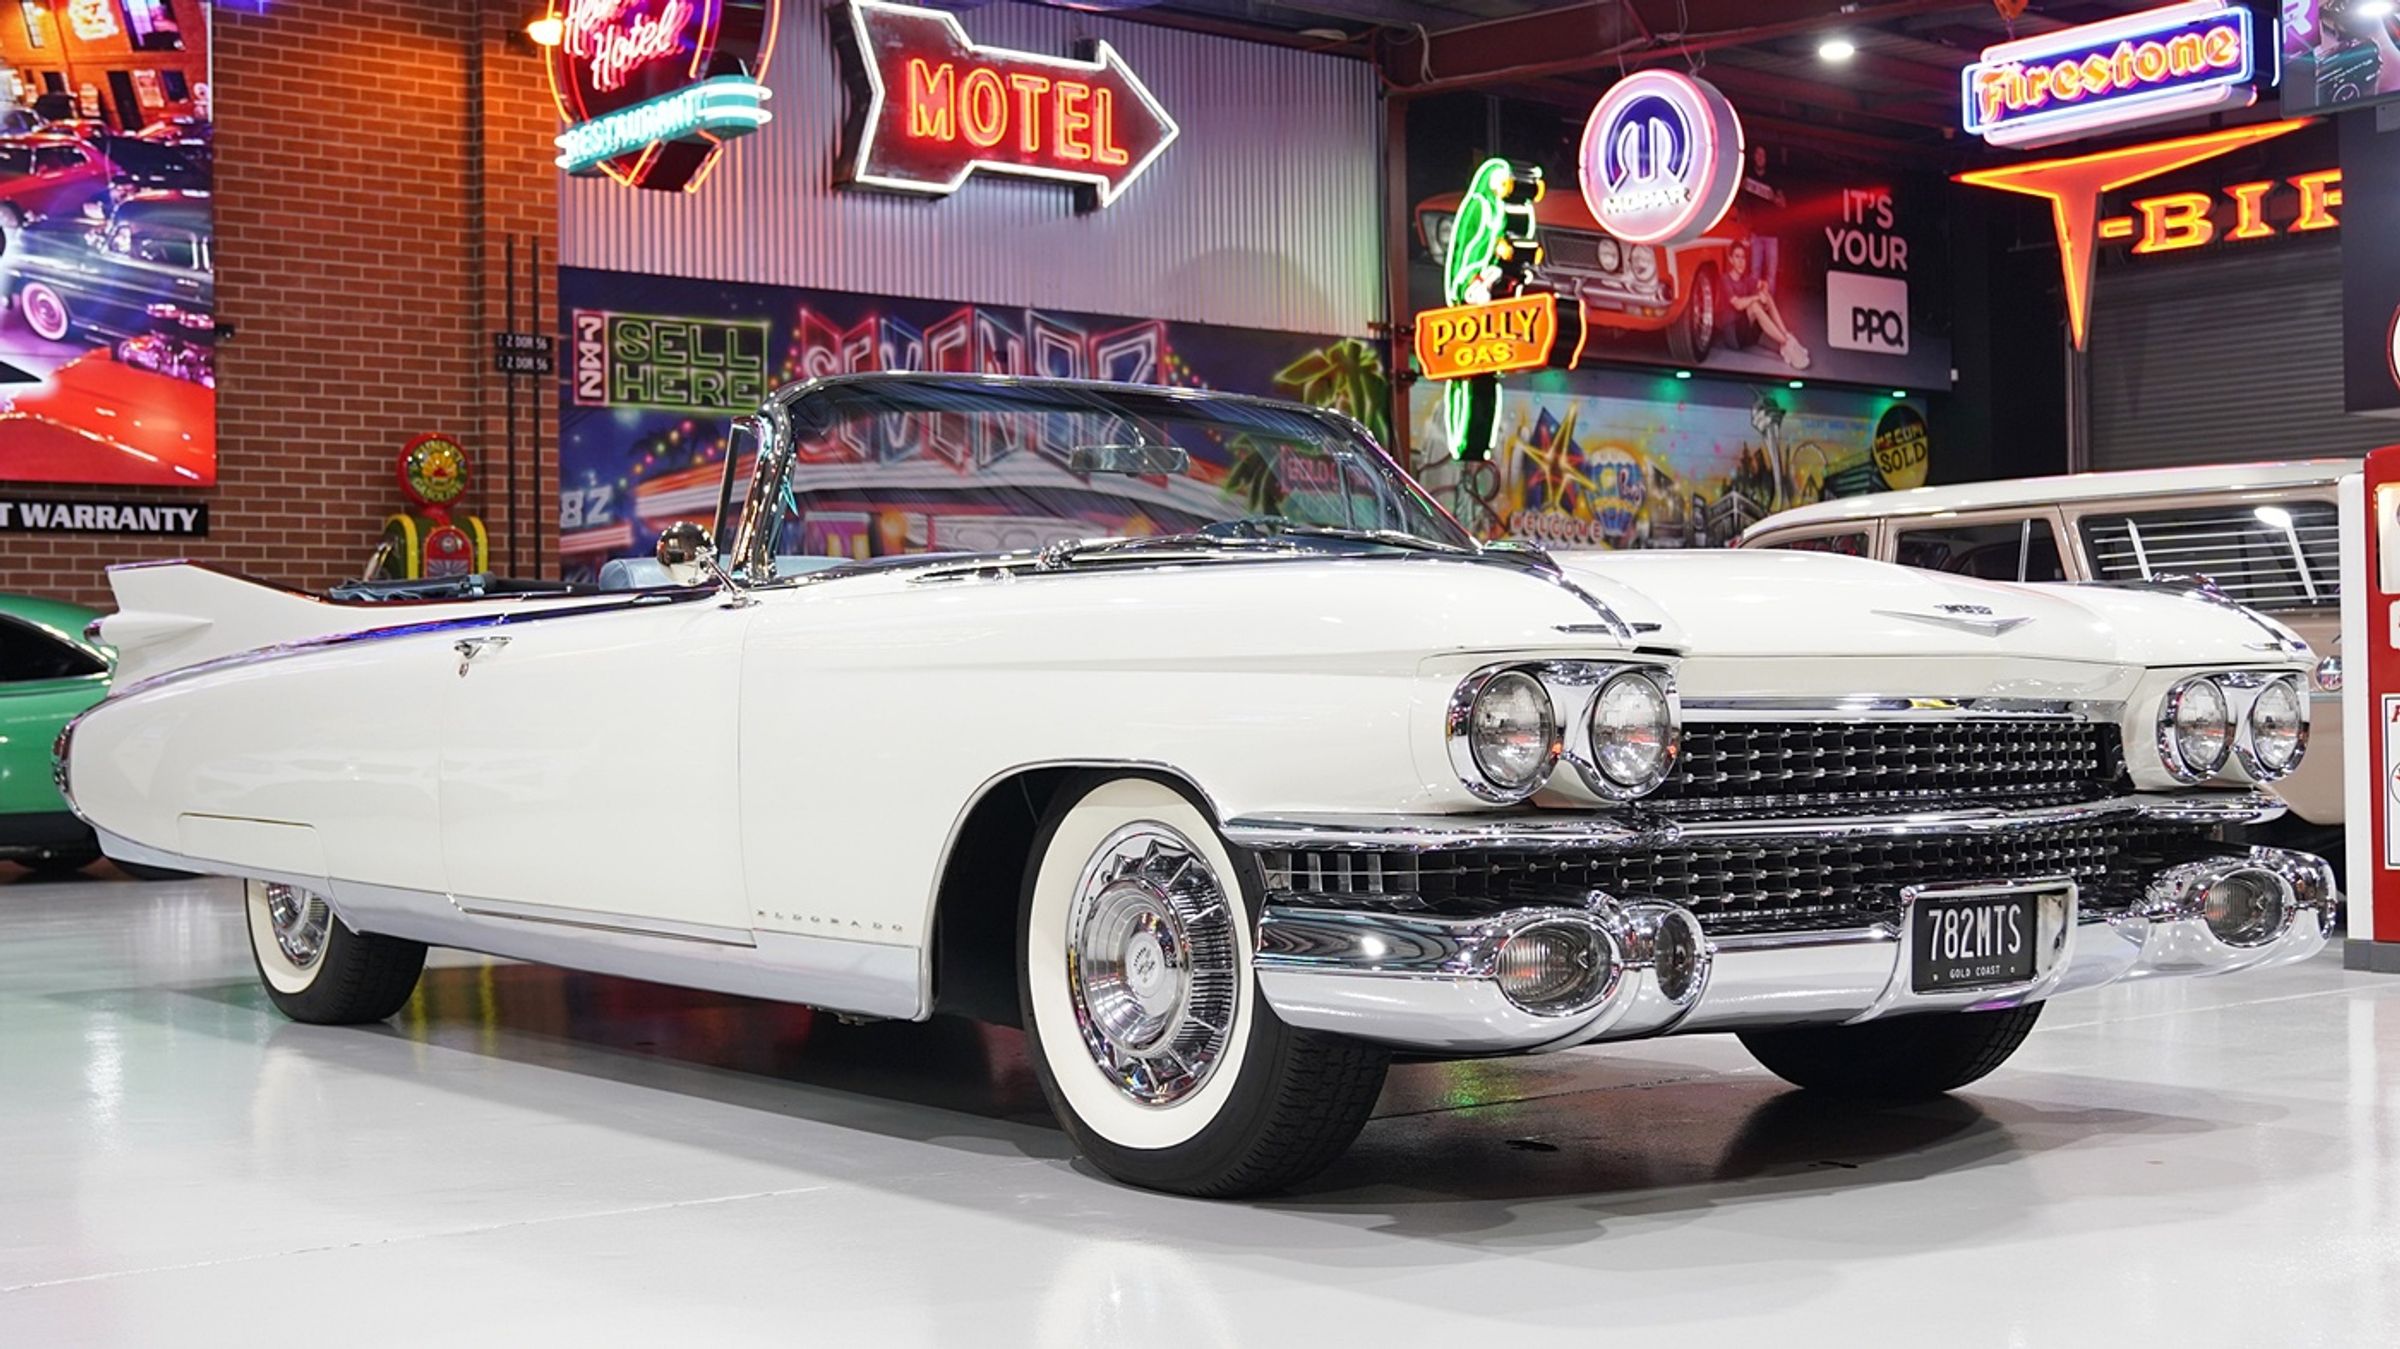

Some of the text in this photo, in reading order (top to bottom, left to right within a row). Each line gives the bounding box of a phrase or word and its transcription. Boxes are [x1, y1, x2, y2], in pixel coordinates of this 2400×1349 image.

[591, 0, 680, 91] Hotel
[1978, 26, 2240, 124] Firestone
[565, 91, 706, 162] RESTAURANT
[908, 57, 1130, 166] MOTEL
[1843, 188, 1895, 230] IT'S
[1825, 225, 1909, 272] YOUR
[615, 319, 762, 370] SELL
[1430, 306, 1542, 356] POLLY
[1851, 306, 1905, 348] PPQ
[1454, 342, 1513, 367] GAS
[615, 363, 763, 408] HERE
[1880, 442, 1926, 474] SOLD
[19, 503, 198, 532] WARRANTY
[1511, 512, 1602, 542] WELCOME
[1928, 904, 2021, 961] 782MTS
[1950, 965, 2000, 979] GOLD COAST
